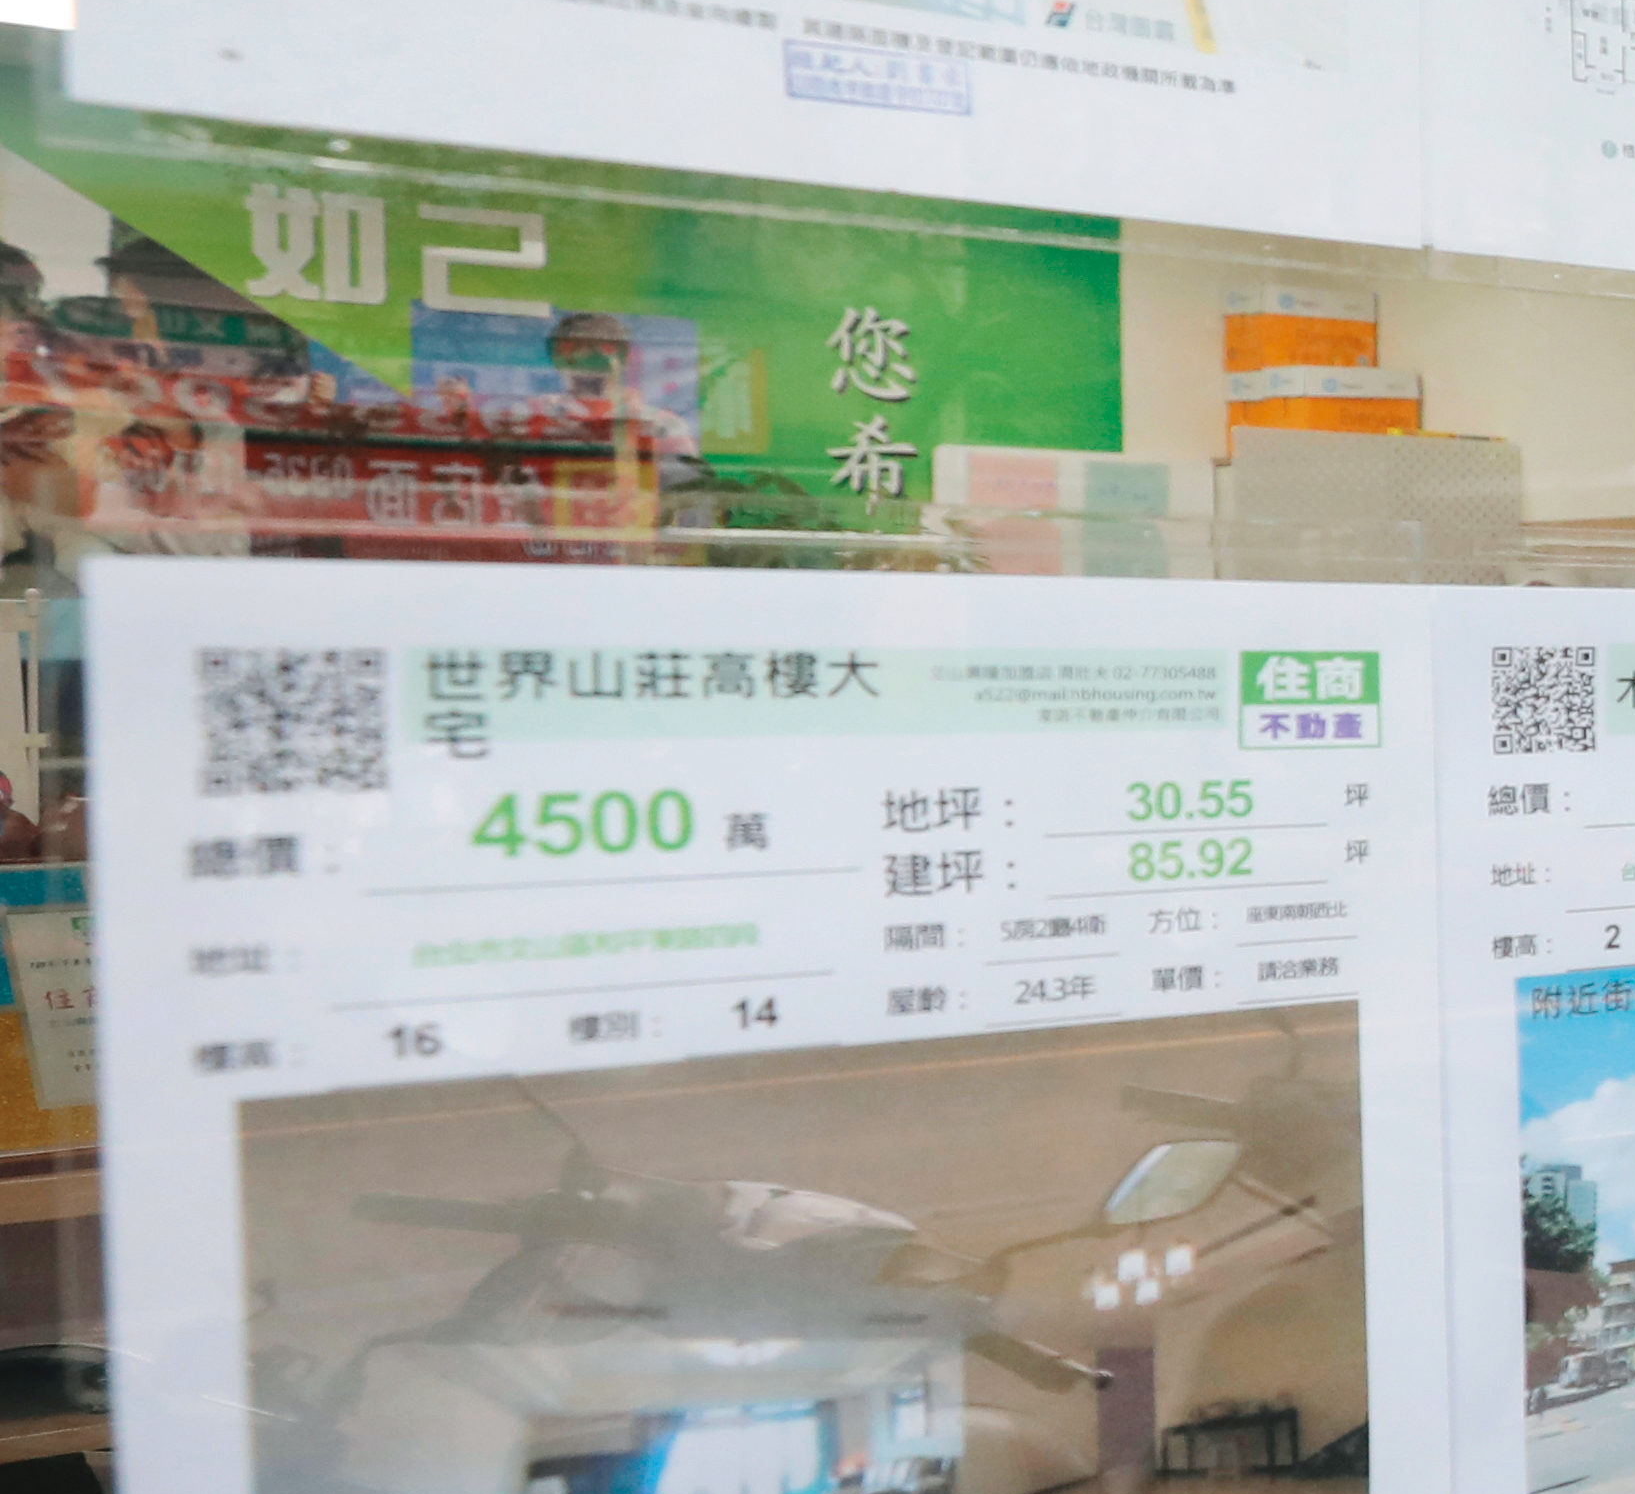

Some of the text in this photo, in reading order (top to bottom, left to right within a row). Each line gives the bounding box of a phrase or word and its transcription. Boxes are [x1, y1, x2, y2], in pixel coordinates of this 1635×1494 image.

[423, 648, 880, 703] 世界山莊高樓大
[1256, 656, 1365, 703] 住商
[423, 709, 490, 761] 宅
[1258, 711, 1364, 740] 不動產
[470, 788, 770, 859] 4500 萬
[1124, 779, 1370, 822] 30.55 坪
[1127, 837, 1370, 883] 85.92 坪
[1604, 924, 1622, 950] 2
[732, 997, 779, 1030] 14
